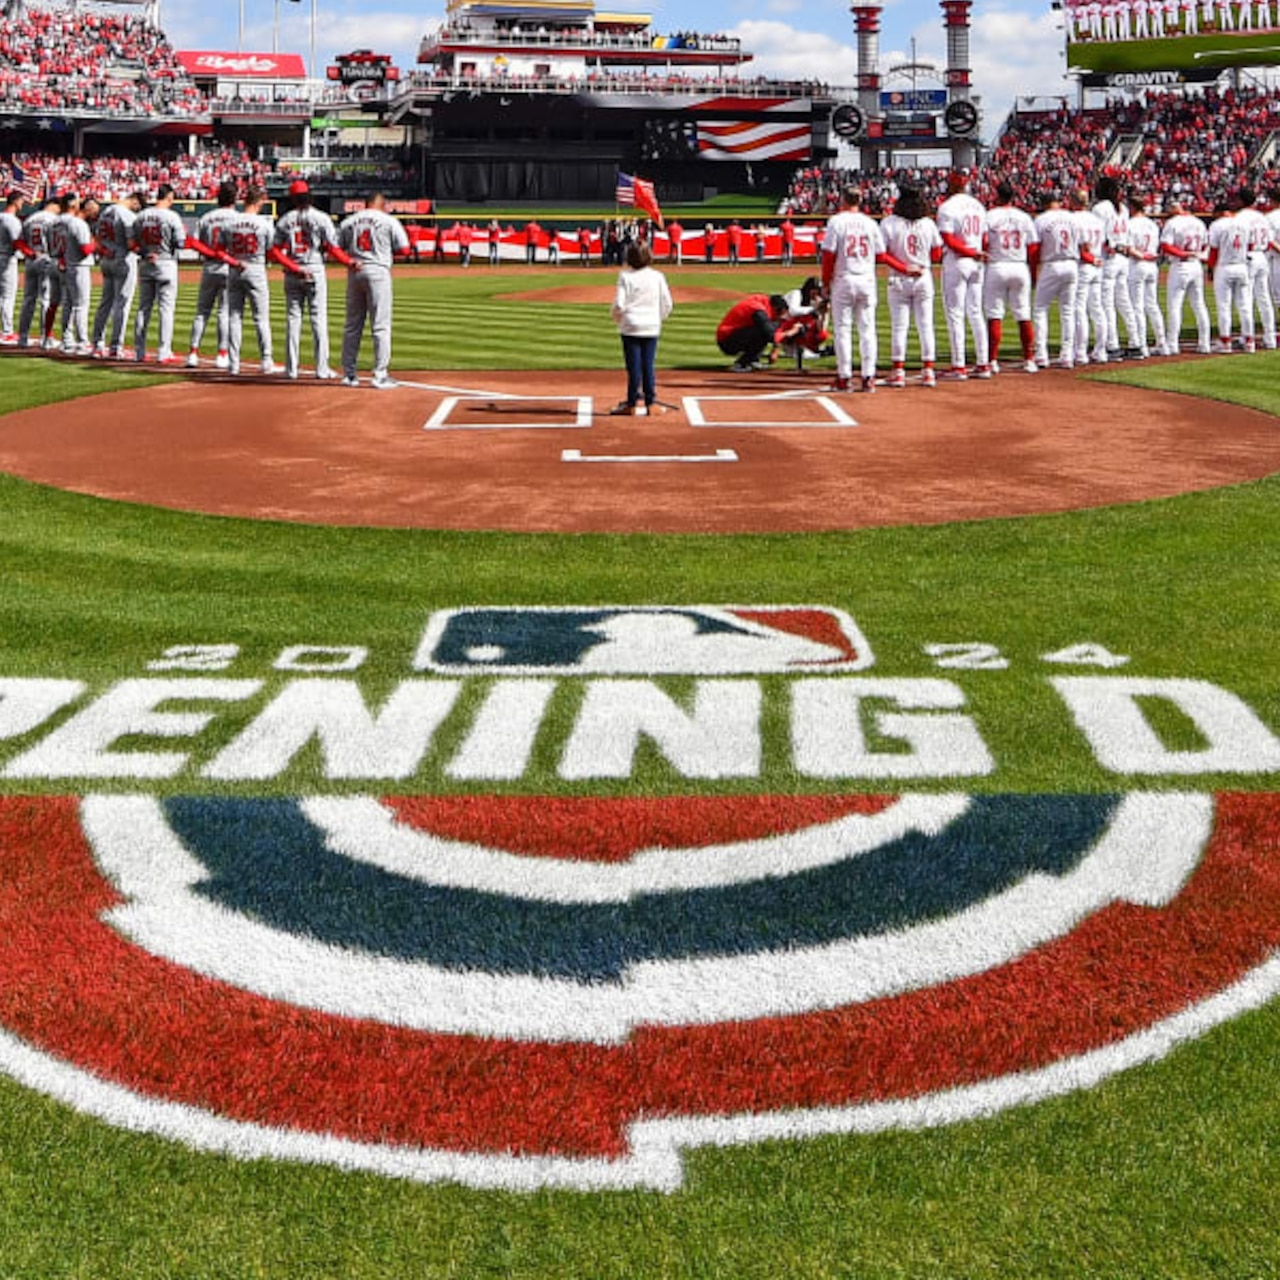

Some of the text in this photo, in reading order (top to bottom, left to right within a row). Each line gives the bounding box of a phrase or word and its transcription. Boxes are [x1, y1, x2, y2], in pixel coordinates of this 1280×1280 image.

[341, 67, 383, 79] TUNDRA
[1114, 71, 1180, 86] GRAVITY
[963, 215, 981, 236] 30
[356, 228, 372, 252] 4
[846, 234, 869, 258] 25
[1000, 230, 1021, 250] 33
[144, 642, 1131, 673] 20 24
